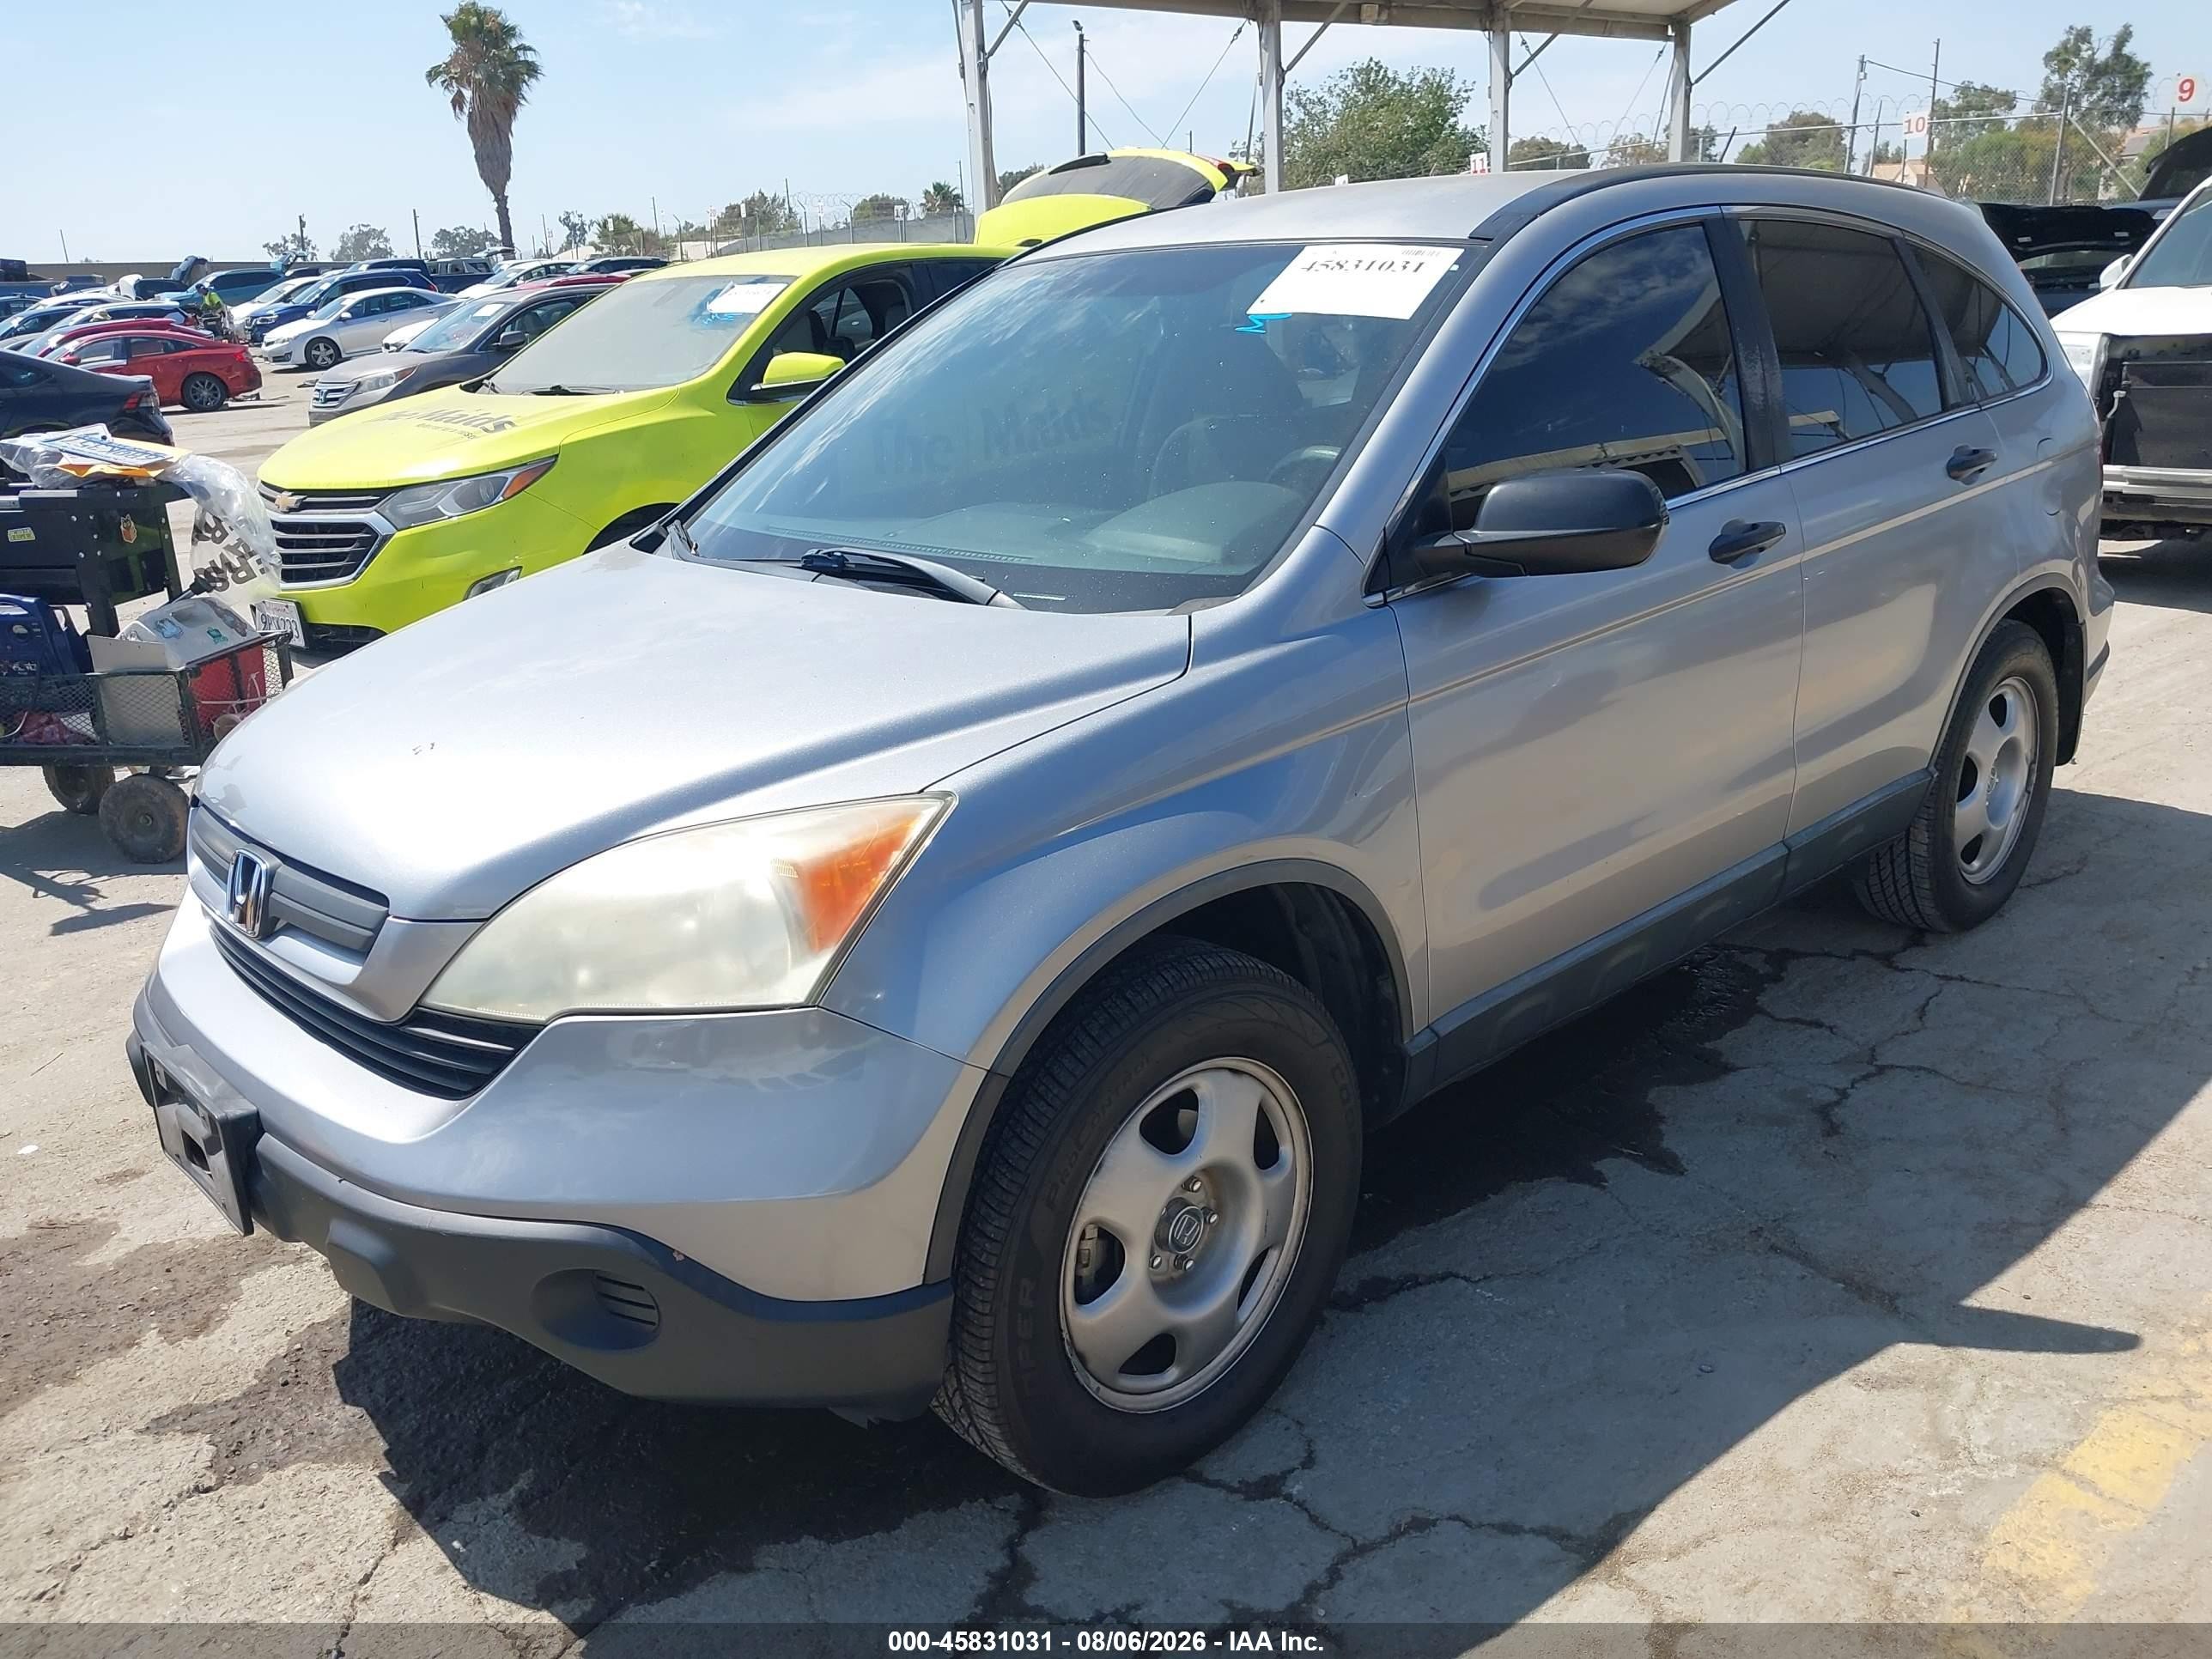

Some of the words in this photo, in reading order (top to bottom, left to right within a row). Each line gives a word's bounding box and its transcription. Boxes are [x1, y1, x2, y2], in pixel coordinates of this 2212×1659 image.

[2178, 78, 2195, 102] 9
[1904, 116, 1926, 135] 10
[1301, 258, 1425, 274] 45831031
